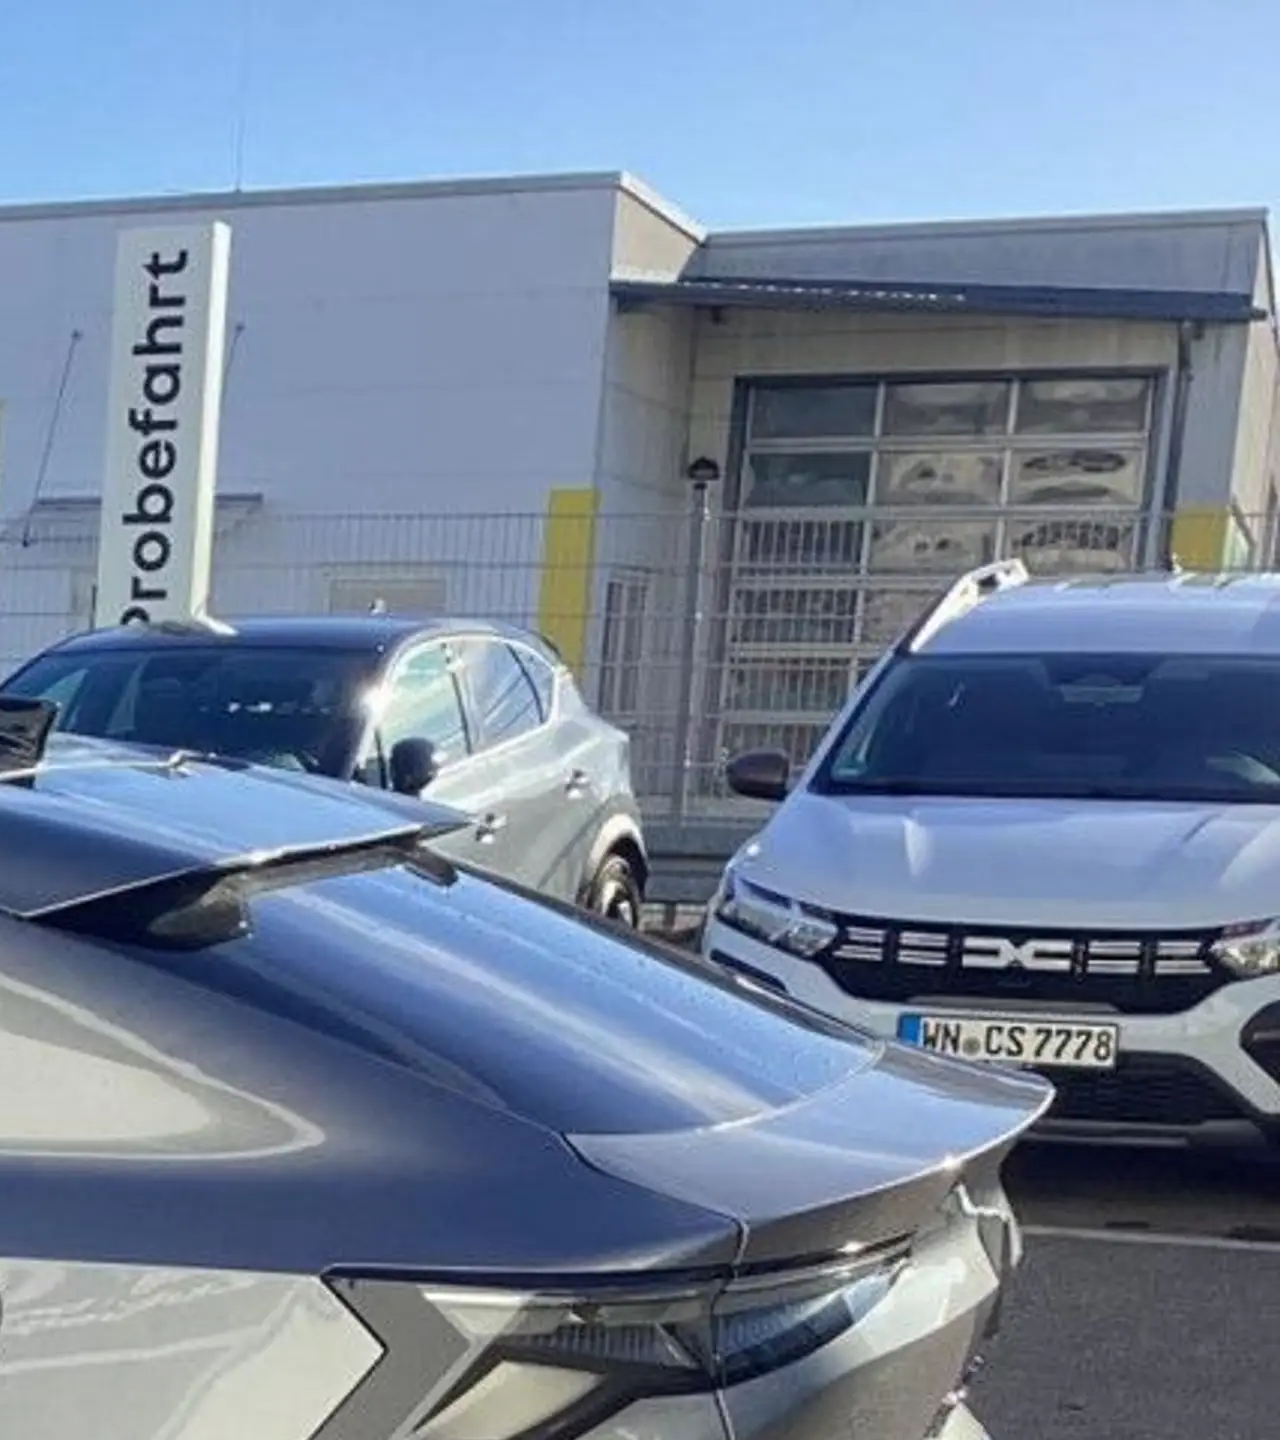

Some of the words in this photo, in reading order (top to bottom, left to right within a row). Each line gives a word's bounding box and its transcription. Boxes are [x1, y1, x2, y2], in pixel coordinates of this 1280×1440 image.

[923, 1018, 961, 1053] WN
[985, 1025, 1027, 1059] CS
[1034, 1027, 1113, 1062] 7778
